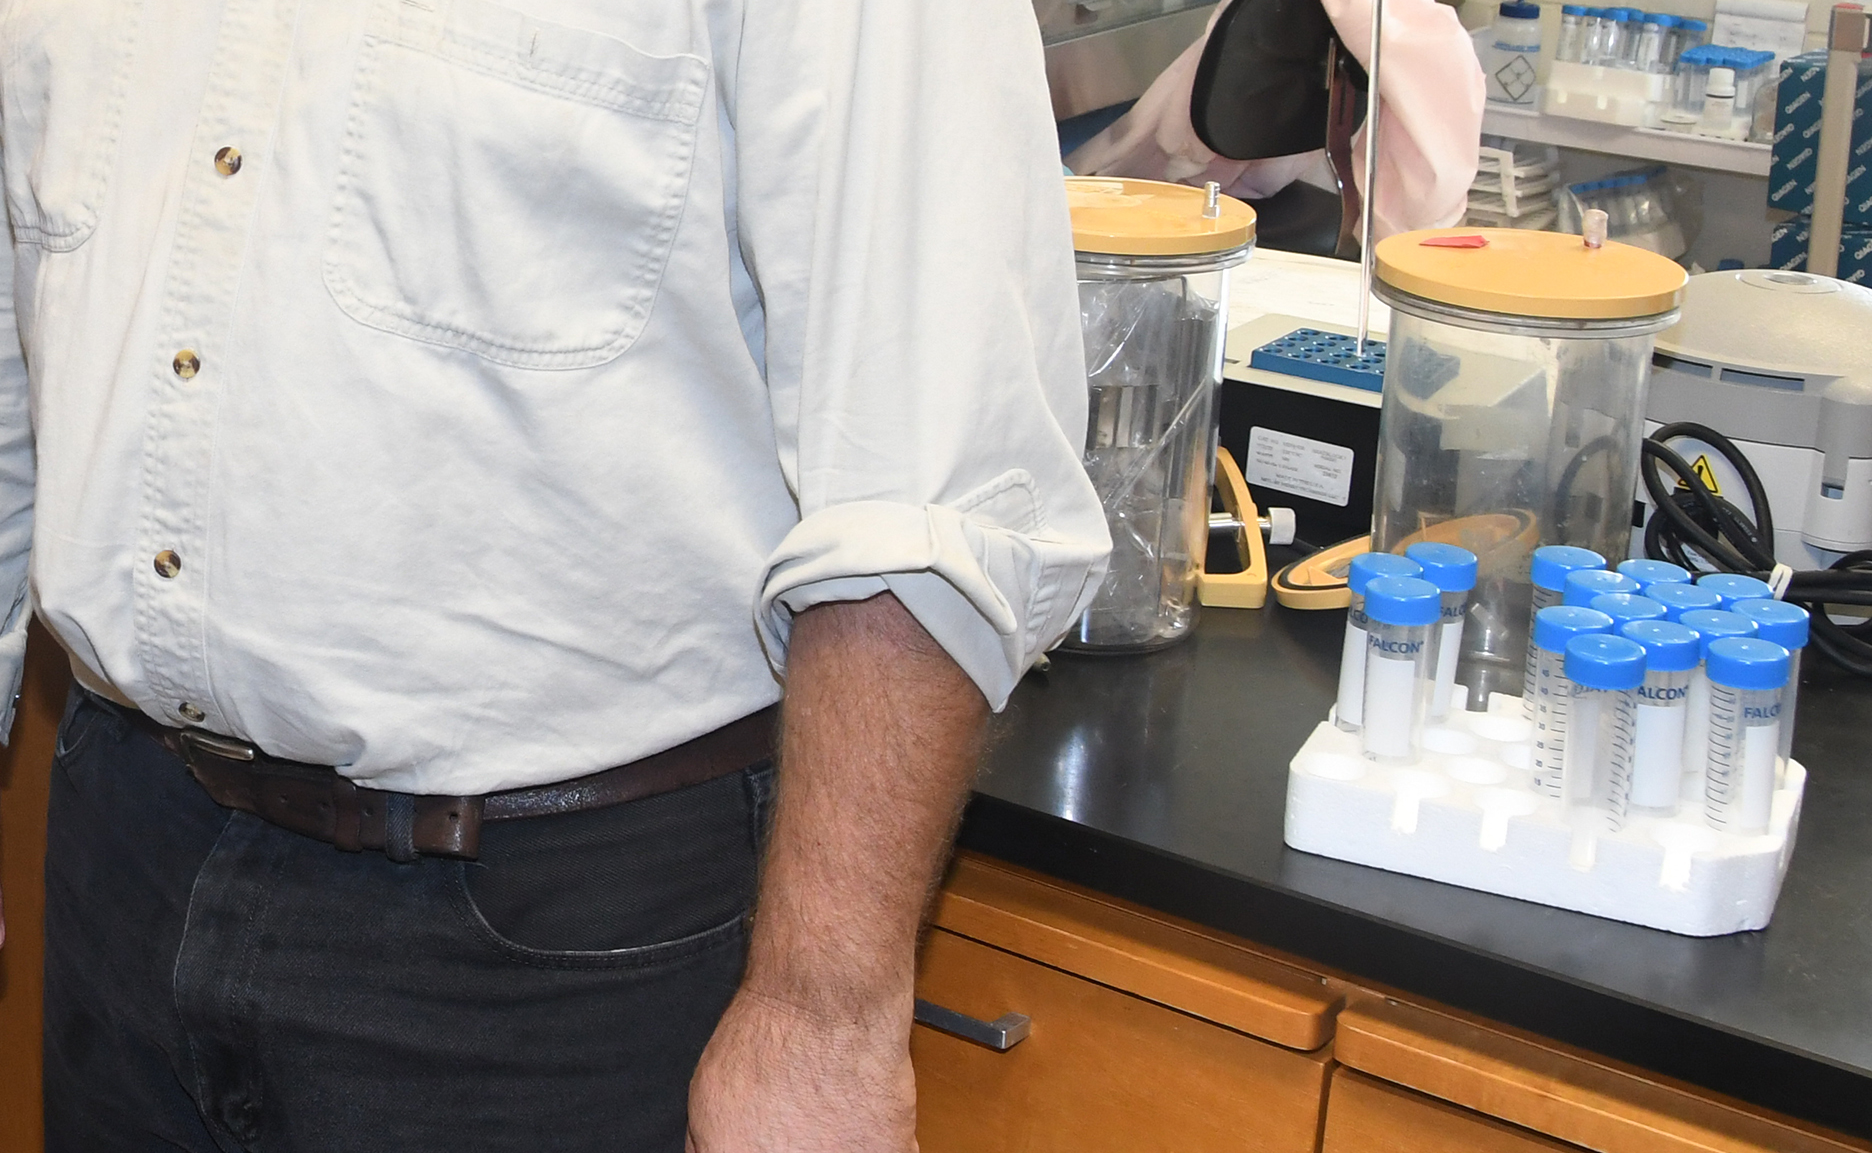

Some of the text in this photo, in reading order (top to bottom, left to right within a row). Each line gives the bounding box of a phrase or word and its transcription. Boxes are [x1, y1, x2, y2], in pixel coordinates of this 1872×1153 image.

[1785, 91, 1811, 114] QIAGEN
[1787, 148, 1813, 170] QIAGEN
[1771, 178, 1797, 202] QIAGEN
[1637, 685, 1686, 701] ALCON
